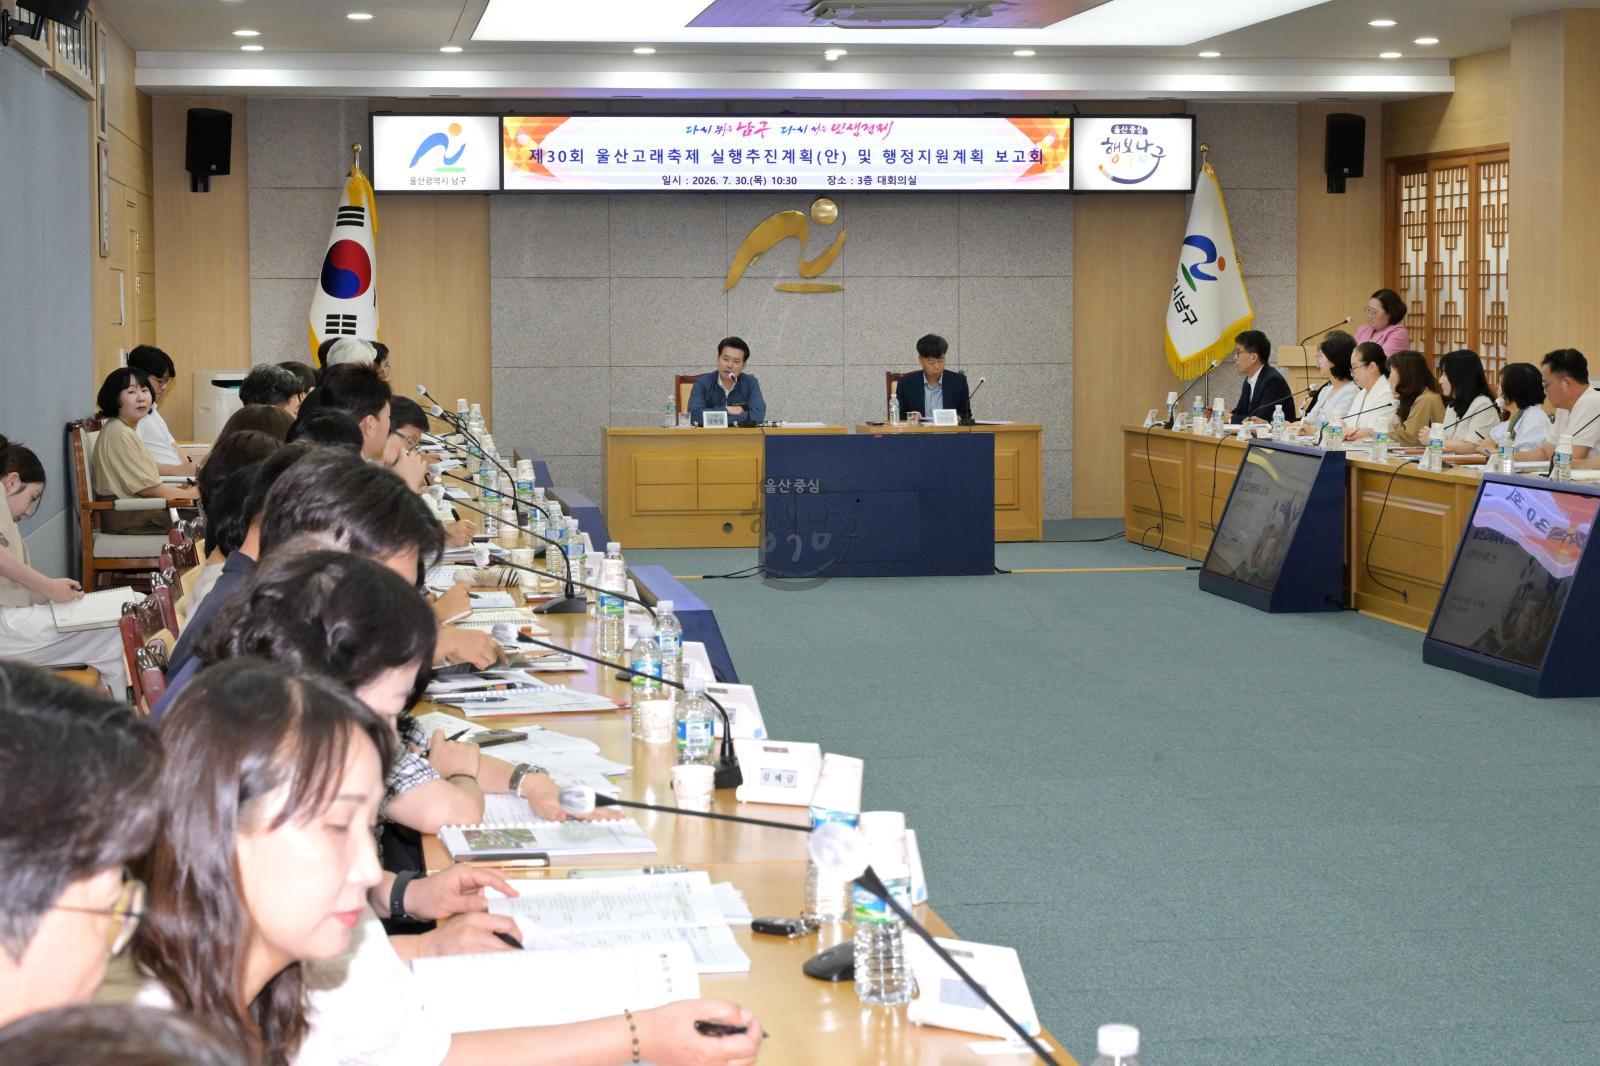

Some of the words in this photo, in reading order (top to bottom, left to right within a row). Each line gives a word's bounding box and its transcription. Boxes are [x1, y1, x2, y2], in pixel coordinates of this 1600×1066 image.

[685, 124, 713, 136] 다시
[736, 120, 771, 140] 남구
[780, 124, 809, 136] 다시
[831, 120, 895, 141] 민생경제
[528, 148, 584, 165] 제30회
[595, 148, 699, 165] 울산고래축제
[711, 148, 848, 166] 실행추진계획(안)
[858, 149, 871, 165] 및
[882, 148, 984, 165] 행정지원계획
[995, 148, 1043, 165] 보고회
[409, 175, 449, 186] 울산광역시
[451, 175, 466, 186] 남구
[661, 175, 682, 186] 일시
[692, 176, 719, 185] 2026.
[722, 176, 731, 185] 7.
[735, 175, 767, 187] 30.(목)
[771, 176, 798, 185] 10:30
[827, 175, 848, 186] 장소
[857, 175, 873, 186] 3층
[877, 175, 917, 186] 대회의실
[1172, 278, 1199, 326] 시남구
